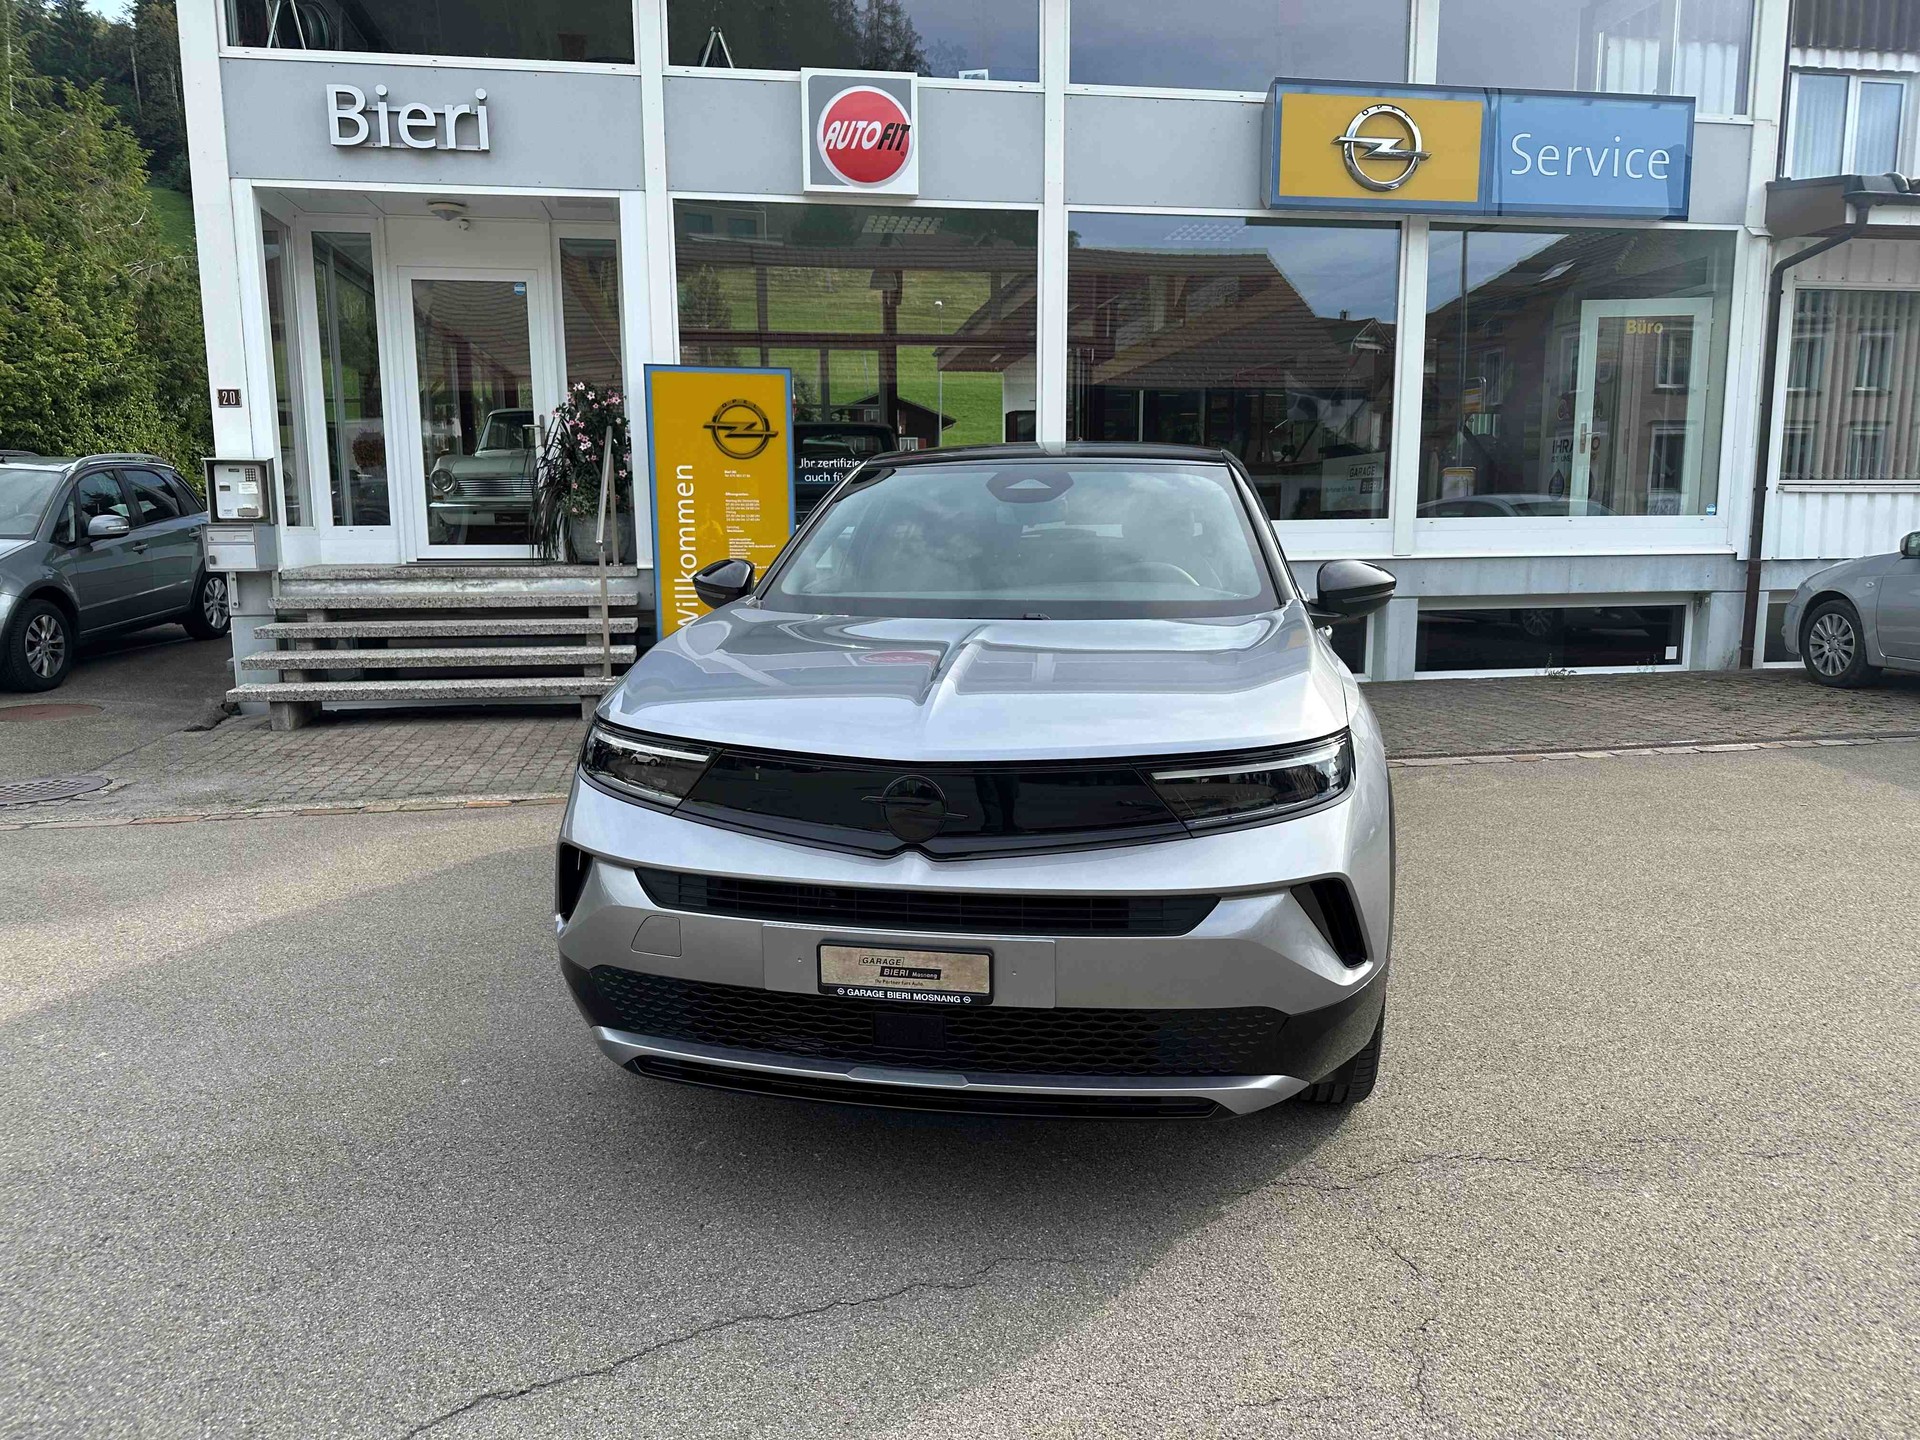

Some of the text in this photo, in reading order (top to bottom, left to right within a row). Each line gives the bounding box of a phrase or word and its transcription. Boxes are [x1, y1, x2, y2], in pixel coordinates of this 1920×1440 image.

[326, 84, 489, 149] Bieri
[1361, 104, 1410, 119] OPEL
[823, 120, 911, 151] AUTOFIT
[1510, 132, 1670, 180] Service
[1625, 319, 1664, 335] Büro
[222, 390, 236, 405] 20
[721, 398, 758, 408] OPEL
[804, 472, 830, 482] auch
[1349, 465, 1376, 478] GARAGE
[862, 957, 902, 966] GARAGE
[883, 969, 938, 980] BIERI Mosnang
[847, 988, 960, 1003] GARAGE BIERI MOSNANG
